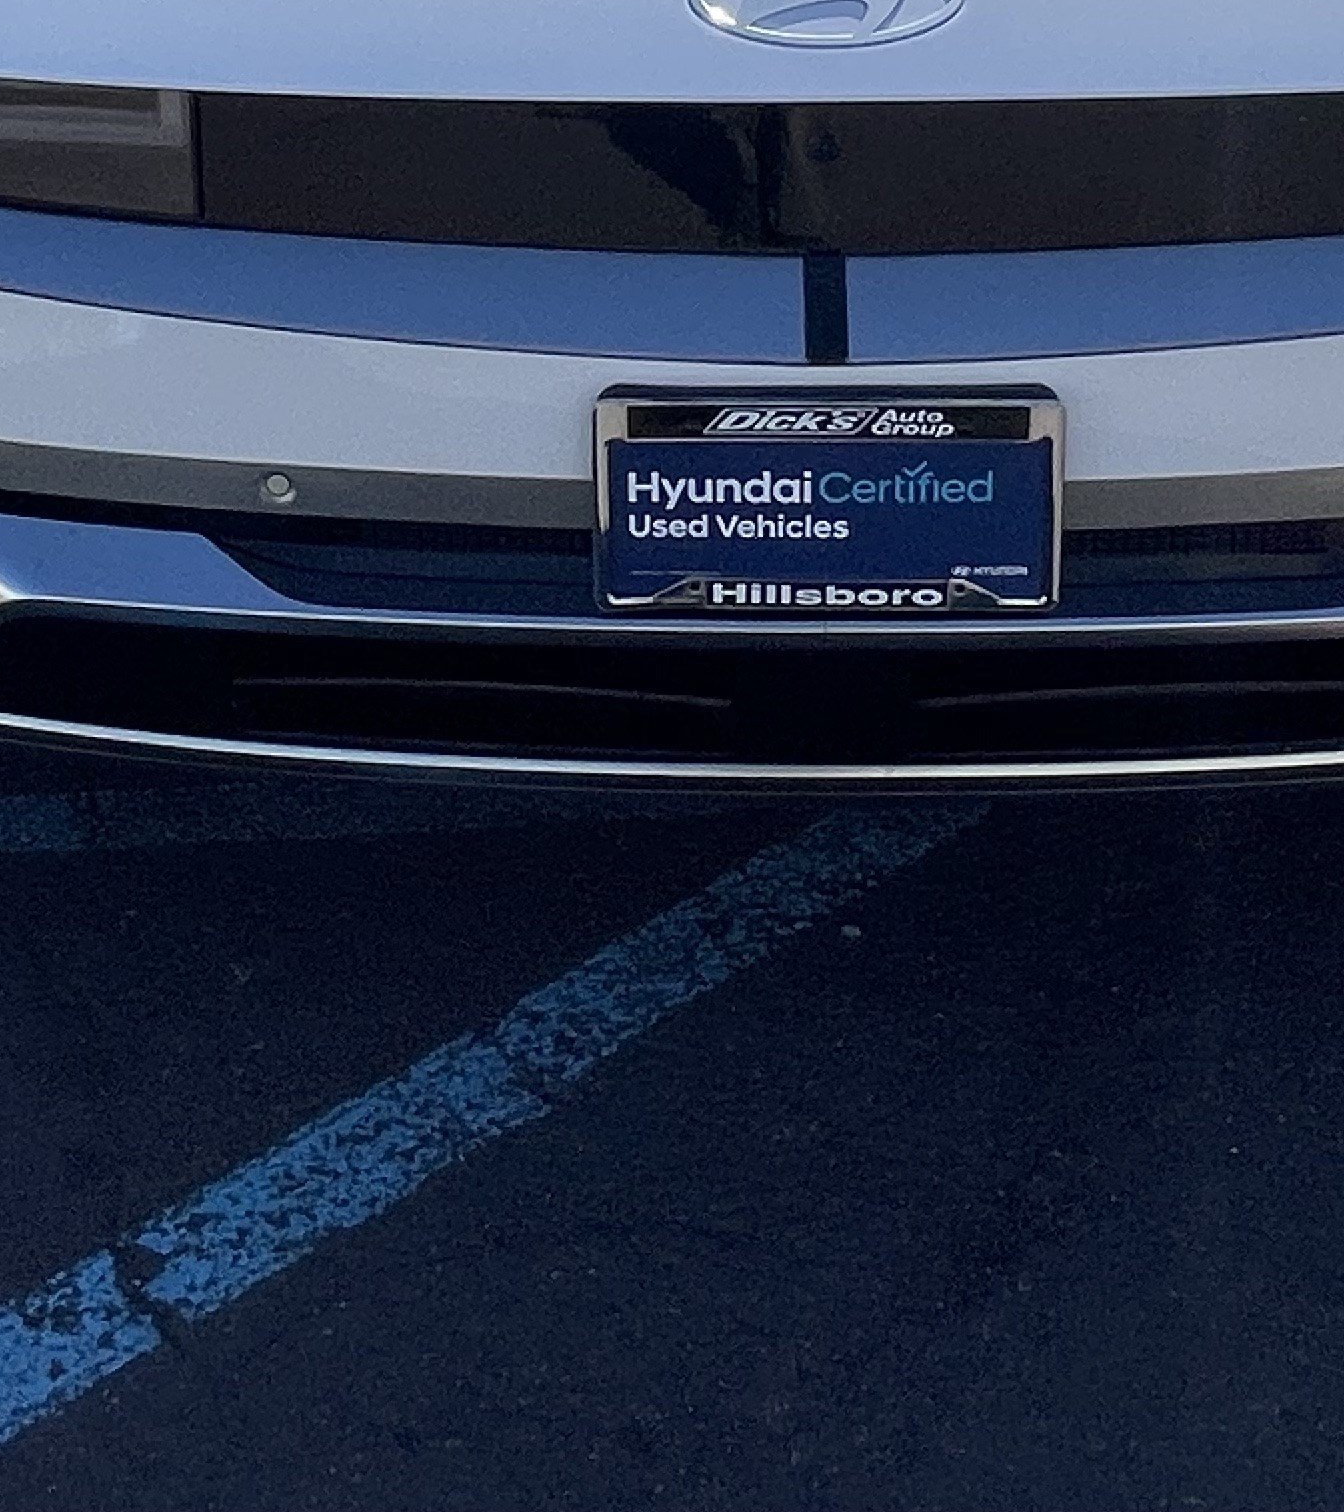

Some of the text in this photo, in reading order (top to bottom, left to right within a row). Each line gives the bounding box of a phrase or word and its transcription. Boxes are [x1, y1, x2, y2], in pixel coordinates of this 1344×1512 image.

[717, 409, 860, 431] Dick's
[879, 408, 944, 423] Auto
[870, 422, 955, 437] Group
[627, 466, 995, 510] Hyundai Certified
[628, 514, 850, 539] Used Vehicles
[712, 582, 943, 606] Hillsboro
